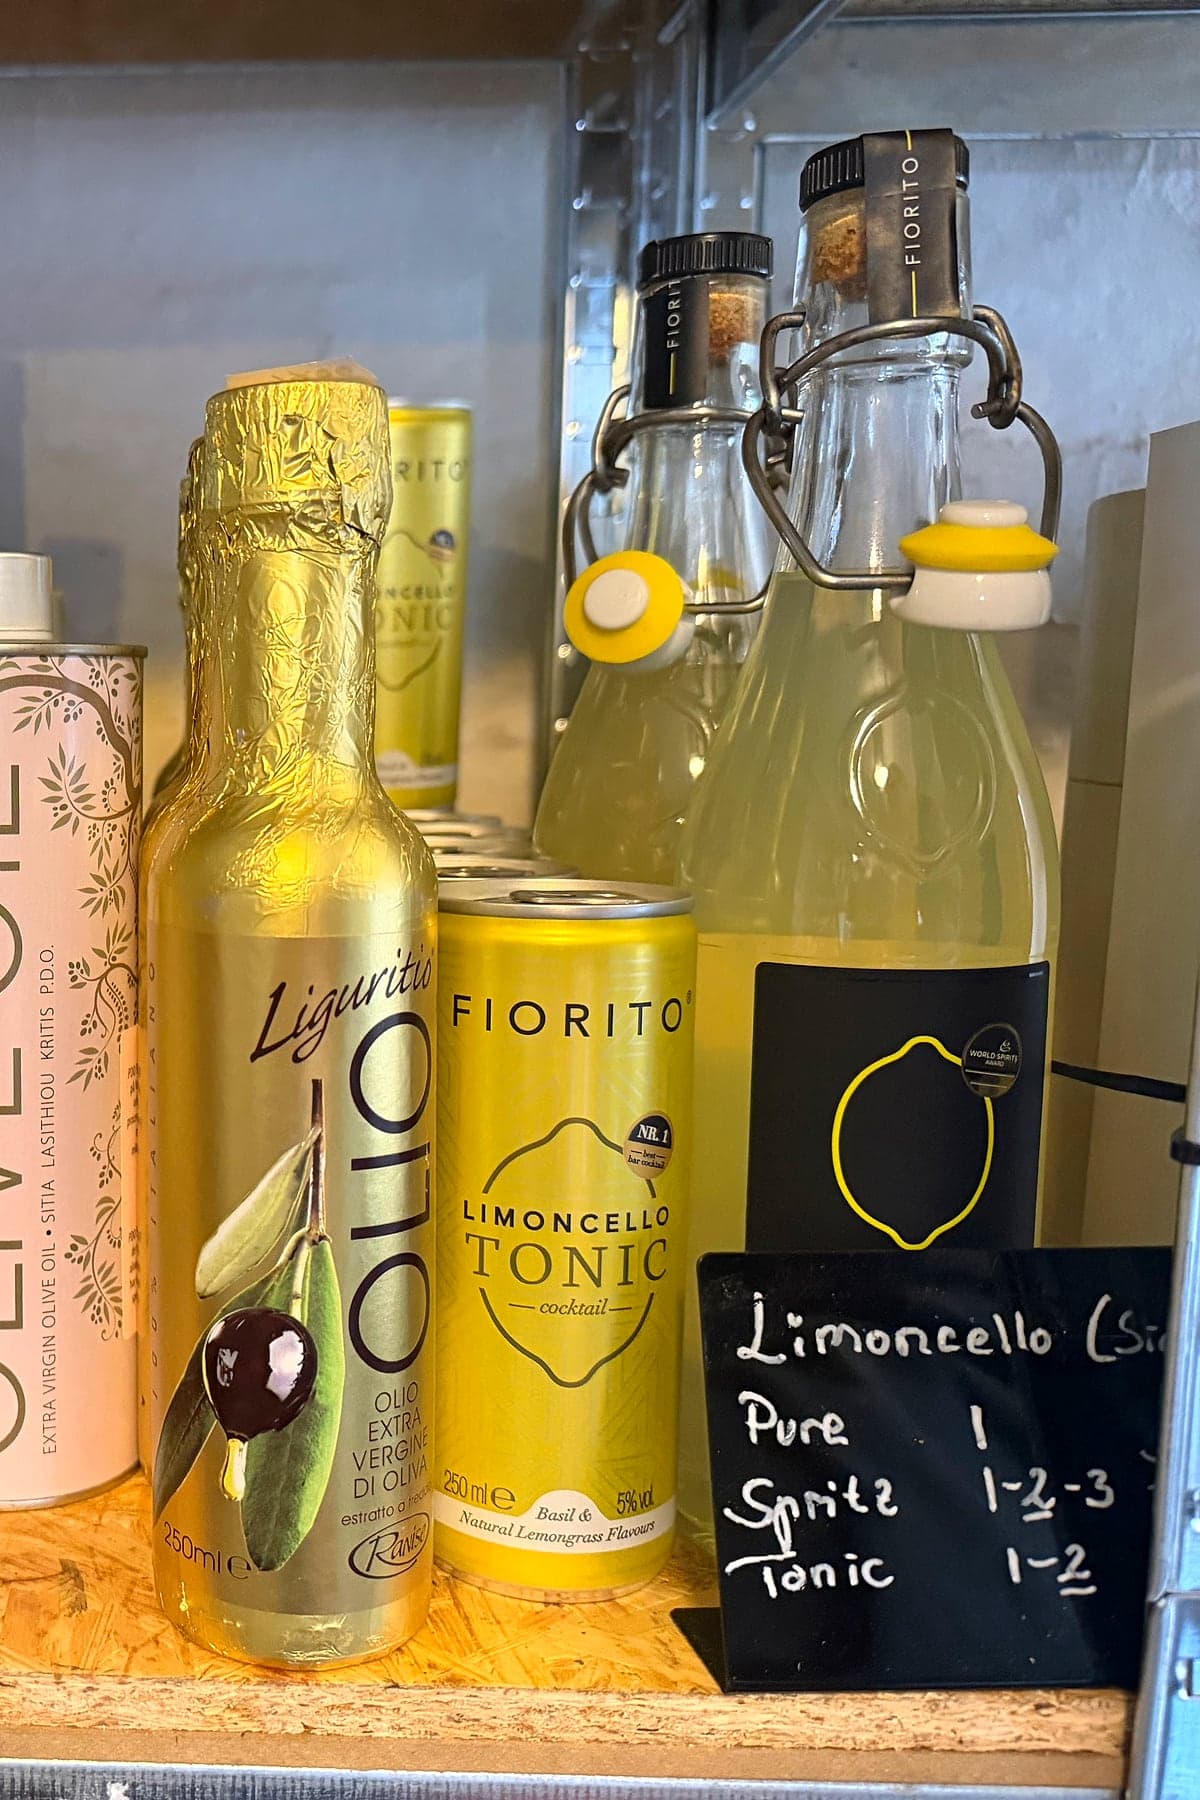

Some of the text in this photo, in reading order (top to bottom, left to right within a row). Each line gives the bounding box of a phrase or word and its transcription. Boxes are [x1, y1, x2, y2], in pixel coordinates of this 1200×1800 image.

[902, 157, 922, 266] FIORITO
[667, 279, 681, 349] FIORIT
[396, 460, 466, 482] RITO
[452, 993, 682, 1038] FIORITO
[969, 1049, 1018, 1064] WORLD SPIRITS
[636, 1124, 669, 1143] NR. 1
[628, 1155, 666, 1170] bar cocktail
[39, 944, 57, 1455] EXTRA VIRGIN OLIVE OIL SITIA LASITHIOU KRITIS P.D.O.
[348, 1011, 432, 1374] OLIO
[462, 1199, 670, 1234] LIMONCELLO
[465, 1232, 667, 1288] TONIC
[539, 1298, 608, 1316] cocktail
[736, 1291, 1054, 1366] Limoncello
[374, 1381, 419, 1413] OLIO
[368, 1407, 422, 1442] EXTRA
[737, 1390, 849, 1446] Pure
[352, 1425, 428, 1471] VERGINE
[354, 1454, 428, 1499] DI OLIVA
[443, 1469, 468, 1498] 250
[471, 1483, 487, 1505] ml
[340, 1503, 395, 1526] estratto
[397, 1501, 406, 1513] a
[535, 1506, 592, 1523] Basil &
[616, 1484, 655, 1515] 5% vol
[163, 1521, 221, 1574] 250ml
[458, 1510, 656, 1548] Natural Lemongrass Flavours
